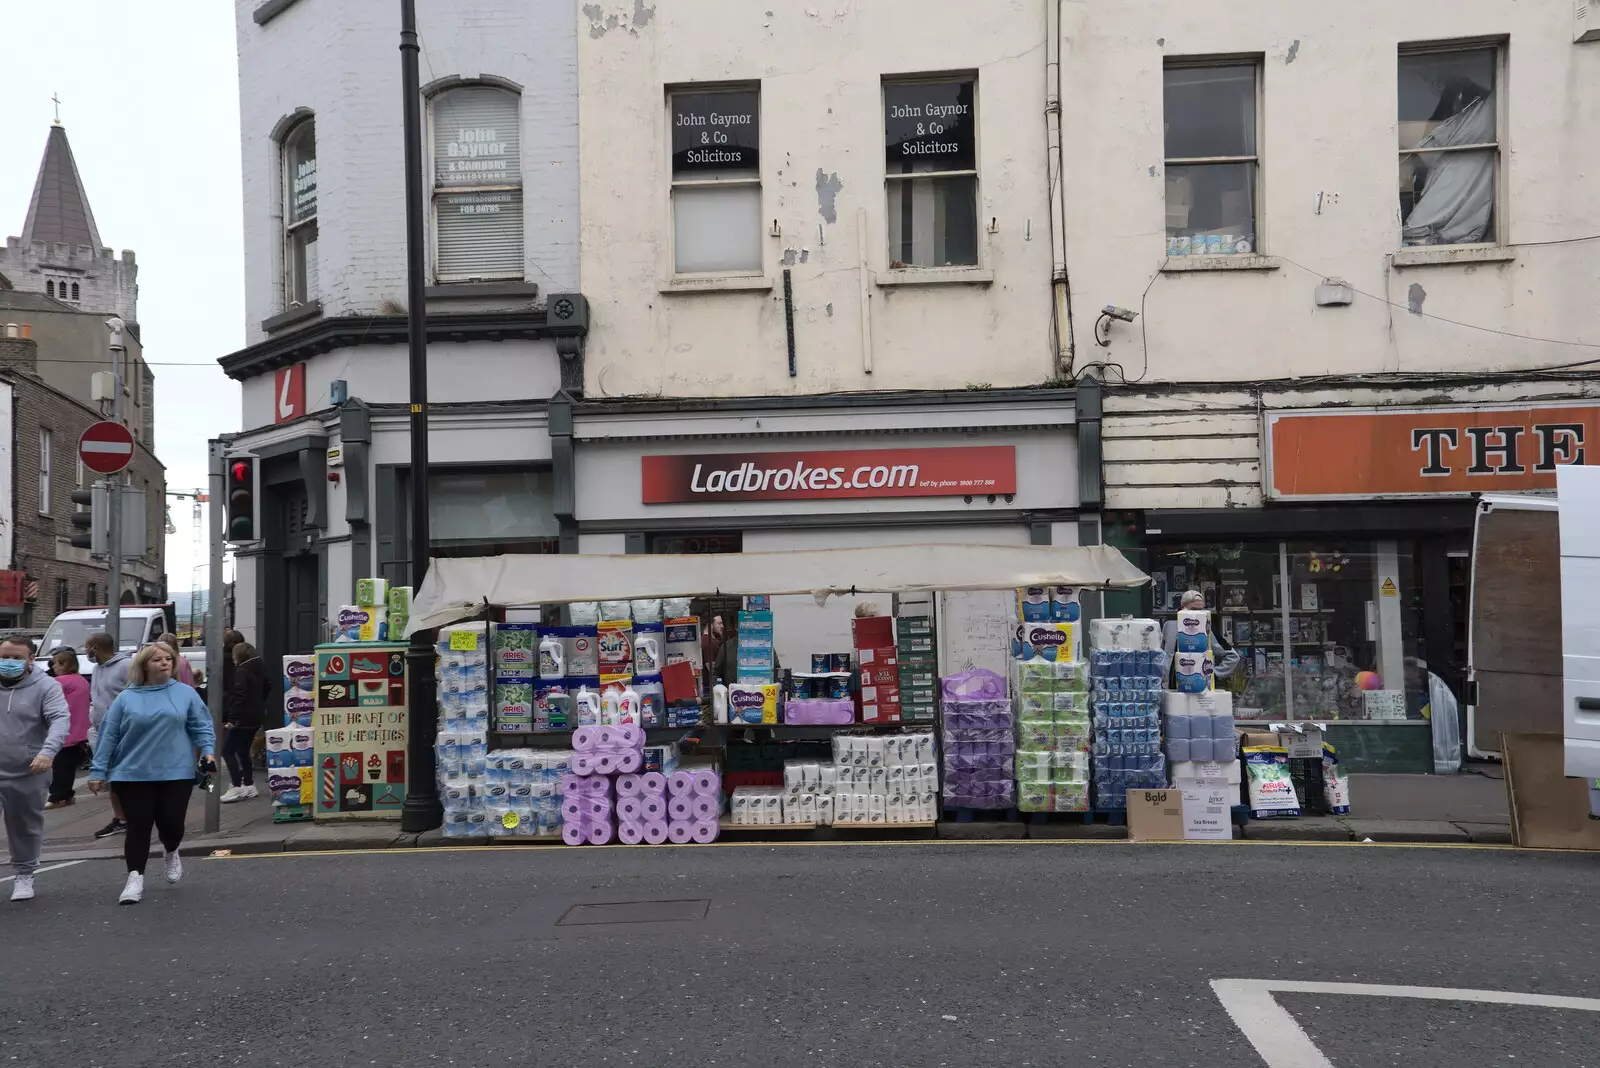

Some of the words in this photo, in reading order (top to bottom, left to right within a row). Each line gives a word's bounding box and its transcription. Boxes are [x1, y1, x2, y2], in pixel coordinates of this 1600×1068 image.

[891, 104, 921, 118] John
[925, 103, 968, 118] Gaynor
[676, 113, 706, 127] John
[710, 112, 752, 128] Gaynor
[458, 128, 496, 143] John
[916, 123, 925, 135] &
[929, 122, 944, 135] Co
[700, 131, 710, 144] &
[713, 131, 728, 144] Co
[448, 142, 506, 157] Gaynor
[902, 141, 958, 155] Solicitors
[687, 149, 742, 163] Solicitors
[1411, 423, 1585, 477] THE
[690, 460, 919, 493] Ladbrokes.com
[930, 480, 939, 488] by
[939, 480, 958, 488] phone
[1031, 632, 1065, 642] Cushelle
[600, 641, 624, 652] Surf
[732, 694, 764, 703] Cushelle
[766, 688, 776, 697] 24
[502, 705, 525, 713] ARIEL
[320, 713, 342, 726] THE
[347, 711, 384, 728] HEART
[388, 711, 405, 724] OF
[322, 730, 345, 745] THE
[348, 729, 405, 745] LIBERTIES
[1263, 781, 1288, 789] ARIEL
[1145, 791, 1167, 802] Bold
